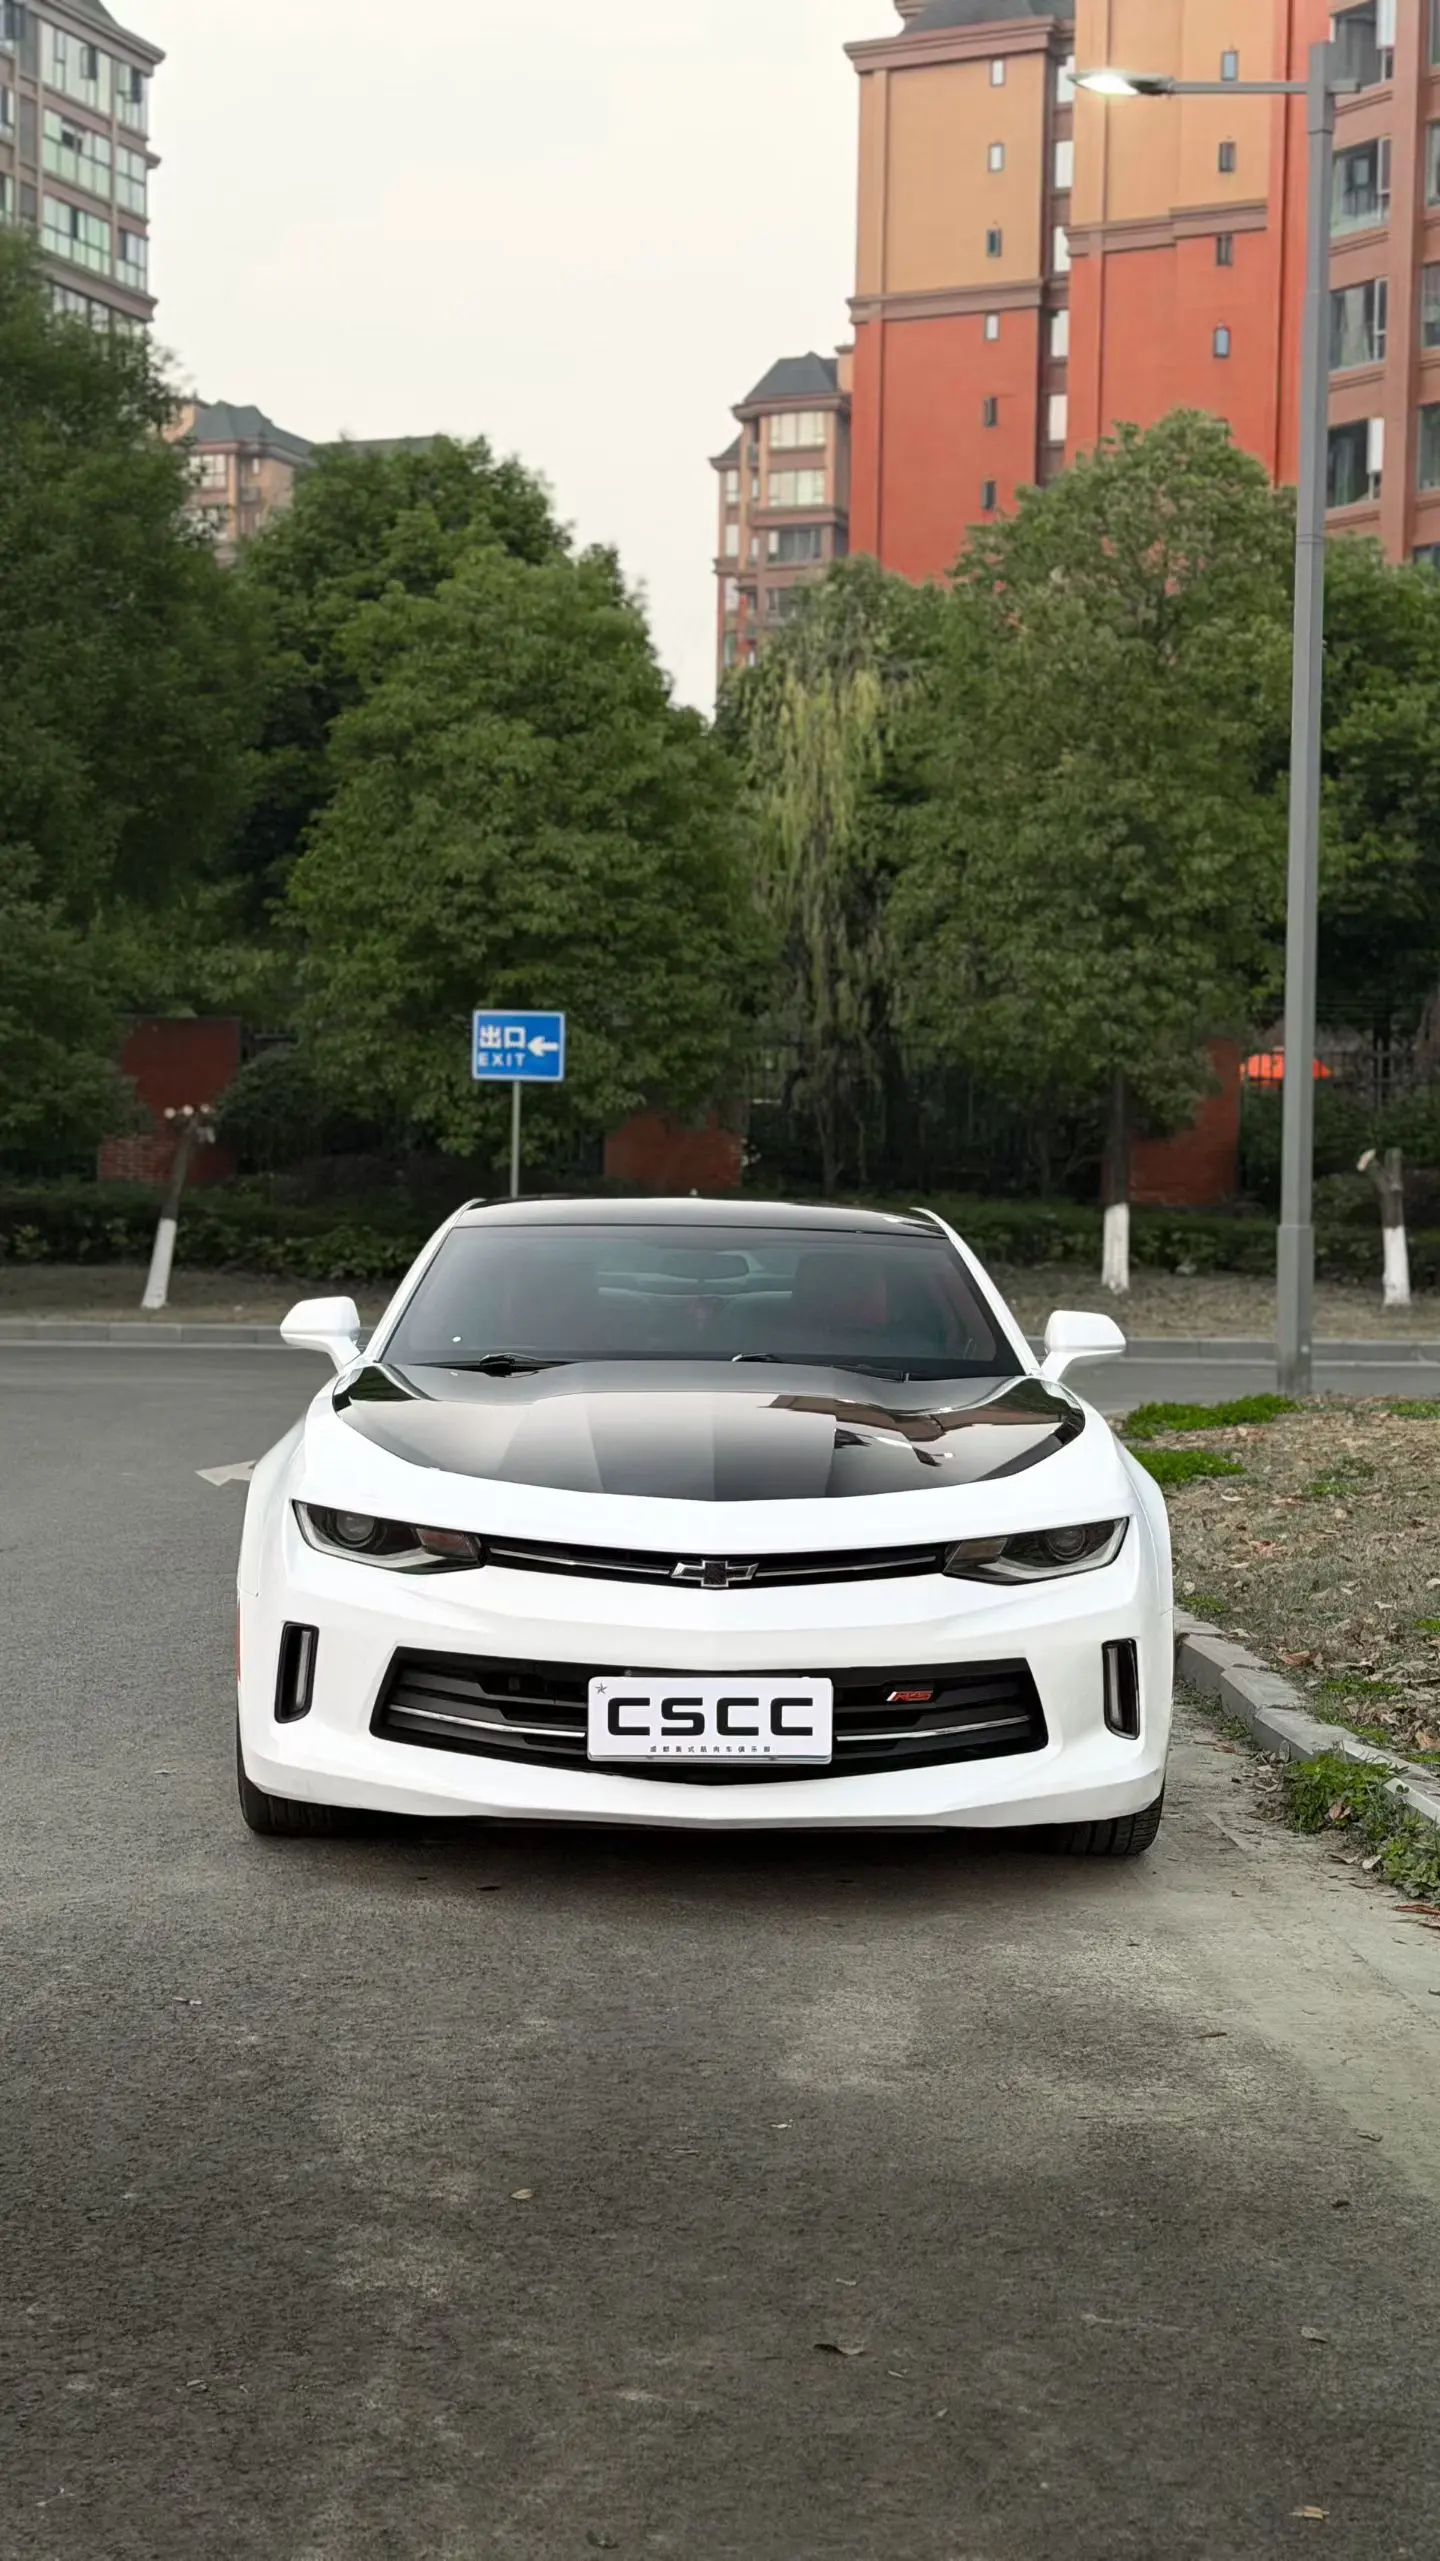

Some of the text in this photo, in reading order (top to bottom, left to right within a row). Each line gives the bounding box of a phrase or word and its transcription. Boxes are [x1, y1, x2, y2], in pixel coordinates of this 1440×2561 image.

[480, 1025, 526, 1049] 出口
[478, 1052, 526, 1067] EXIT
[607, 1697, 814, 1737] CSCC
